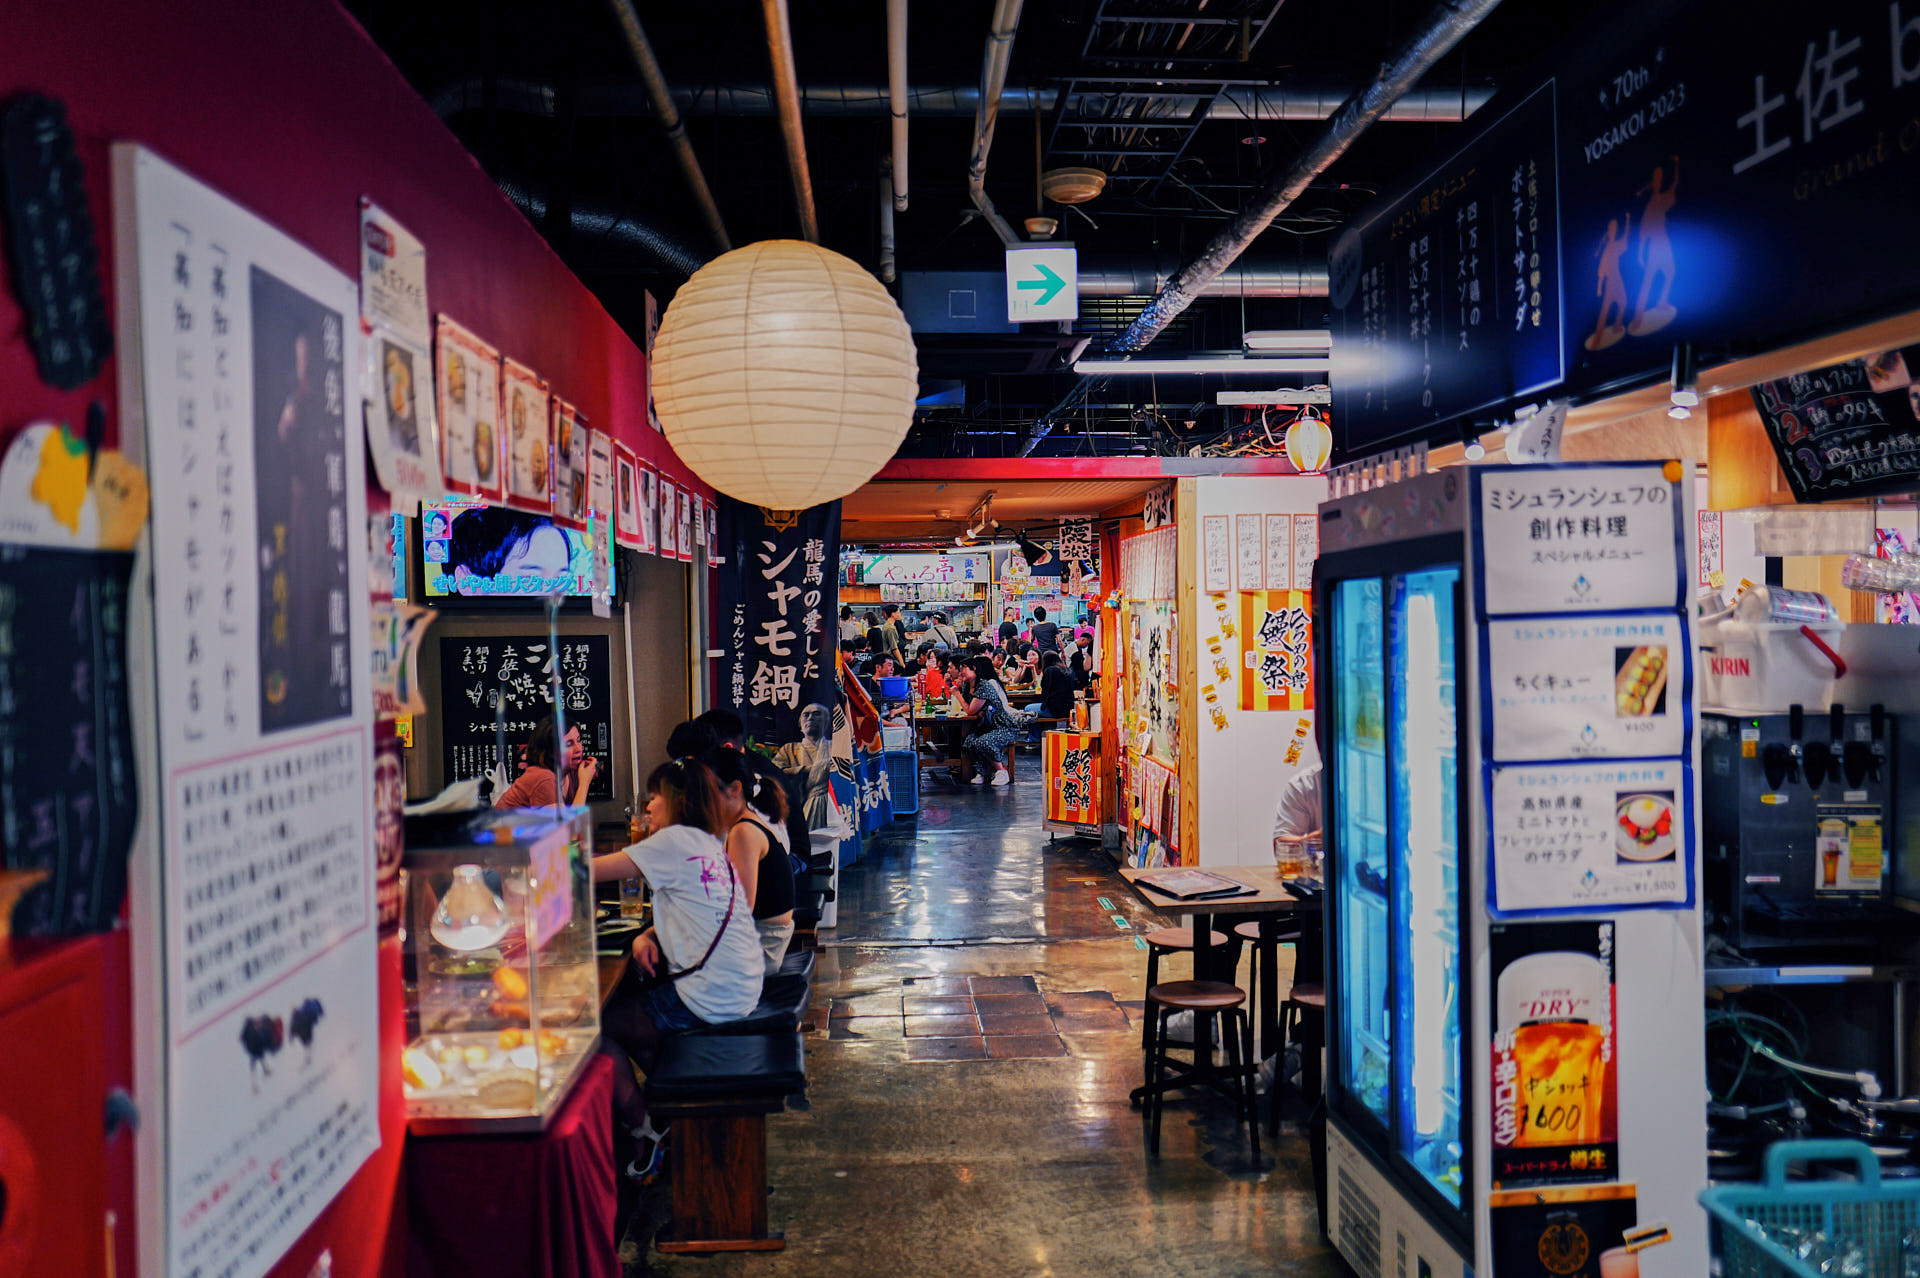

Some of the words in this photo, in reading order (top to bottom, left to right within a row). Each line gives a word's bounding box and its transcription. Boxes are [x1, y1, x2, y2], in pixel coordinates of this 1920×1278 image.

[1613, 66, 1650, 105] 70th
[1732, 29, 1866, 175] 土佐
[1583, 109, 1646, 166] YOSAKOI
[1648, 82, 1689, 125] 2023
[1511, 164, 1529, 332] ポテトサラダ
[1490, 486, 1667, 510] ミシュランシェフの
[1529, 515, 1628, 541] 創作料理
[1062, 544, 1091, 559] うなぎ
[1532, 549, 1644, 564] スペシャルメニュー
[884, 556, 954, 581] やいろ亭
[802, 538, 826, 679] 龍馬の愛した
[749, 540, 802, 710] シャモ鍋
[1514, 625, 1665, 641] ミシュランシェフの創作料理
[475, 646, 489, 674] 鍋より
[575, 644, 590, 672] 鍋より
[731, 603, 746, 709] ごめんシャモ鍋社中
[1711, 657, 1750, 677] KIRIN
[1514, 674, 1591, 691] ちくキュー
[1517, 770, 1665, 786] ミシュランシェフの創作料理
[1522, 795, 1583, 811] 高知県産
[1517, 816, 1589, 830] ミニトマトと
[1525, 848, 1583, 864] のサラダ
[1504, 1160, 1568, 1174] スーパードライ
[1569, 1149, 1607, 1170] 樽生
